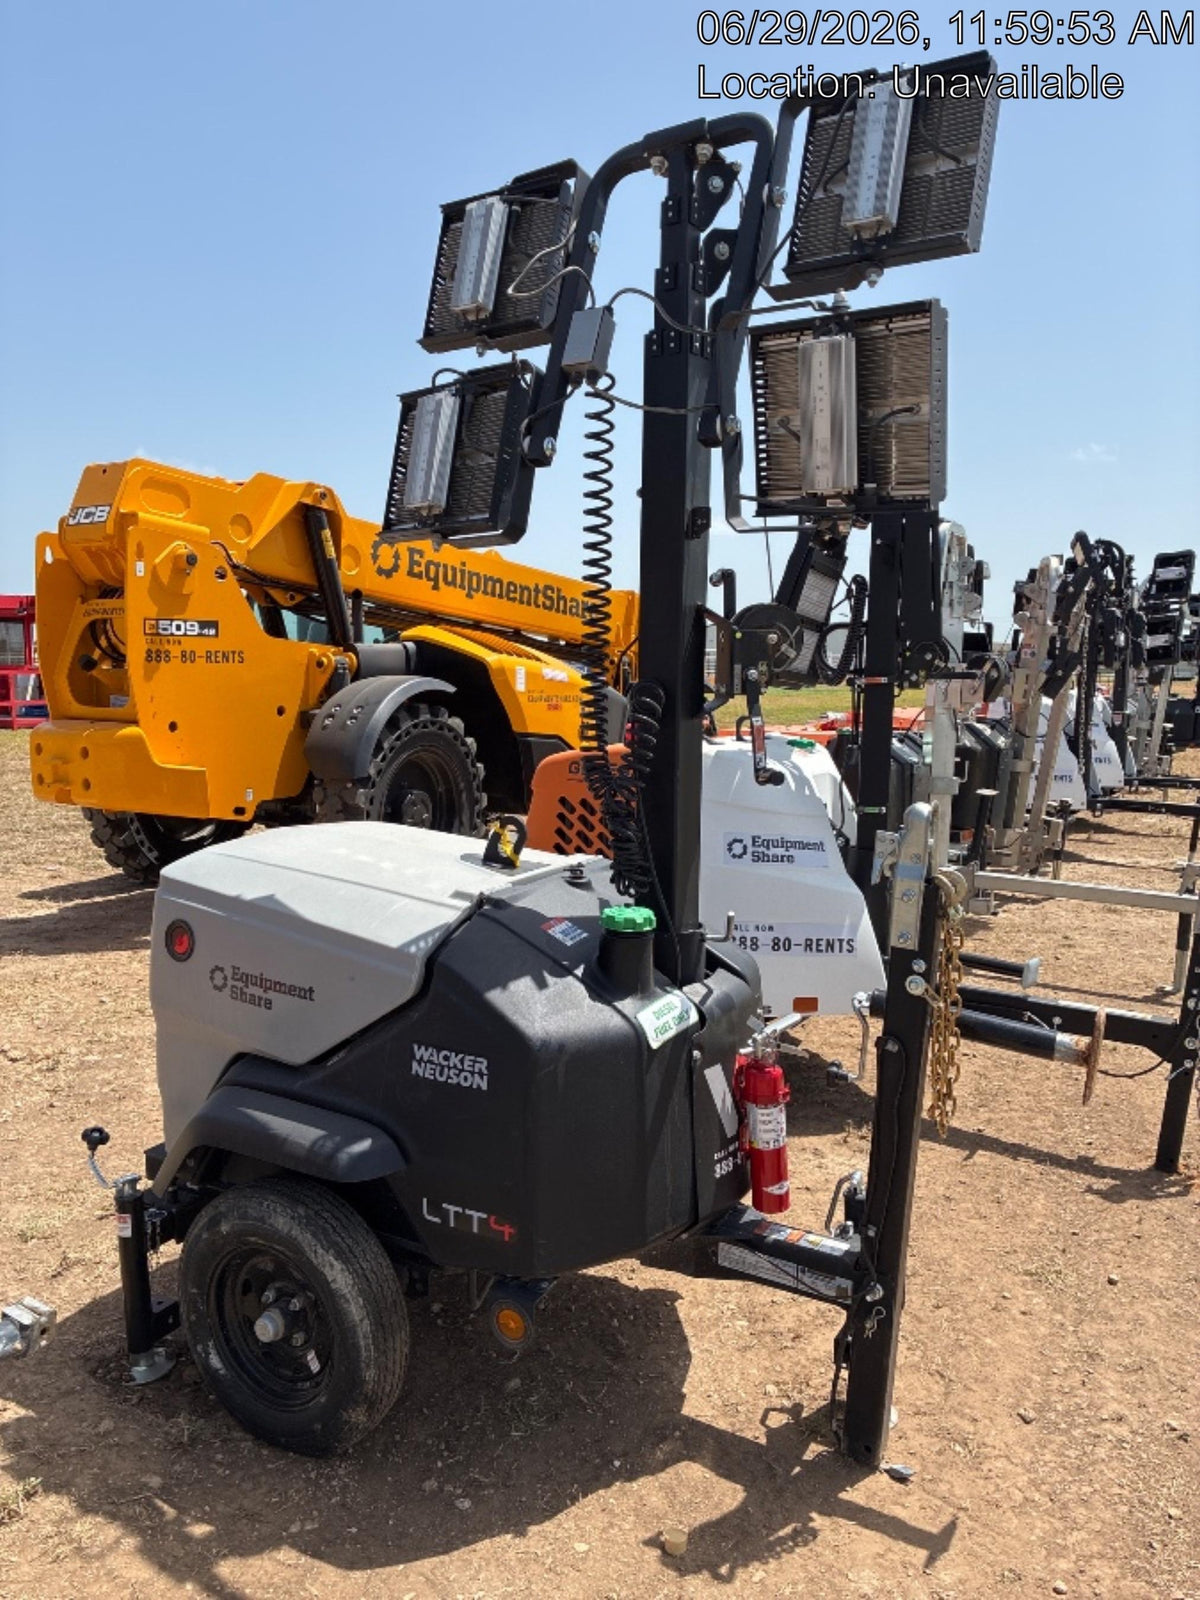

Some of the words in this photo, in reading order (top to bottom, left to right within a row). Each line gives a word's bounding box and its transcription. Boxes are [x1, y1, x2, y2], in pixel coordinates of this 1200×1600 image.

[68, 506, 111, 525] JCB
[406, 546, 601, 619] EquipmentShar
[145, 648, 245, 664] 888-80-RENTS
[751, 835, 826, 852] Equipment
[751, 850, 795, 864] Share
[732, 936, 855, 953] 88-80-RENTS
[230, 965, 316, 1002] Equipment
[229, 984, 273, 1011] Share
[412, 1043, 489, 1074] WACKER
[411, 1060, 489, 1091] NEUSON
[422, 1197, 516, 1242] LTT4
